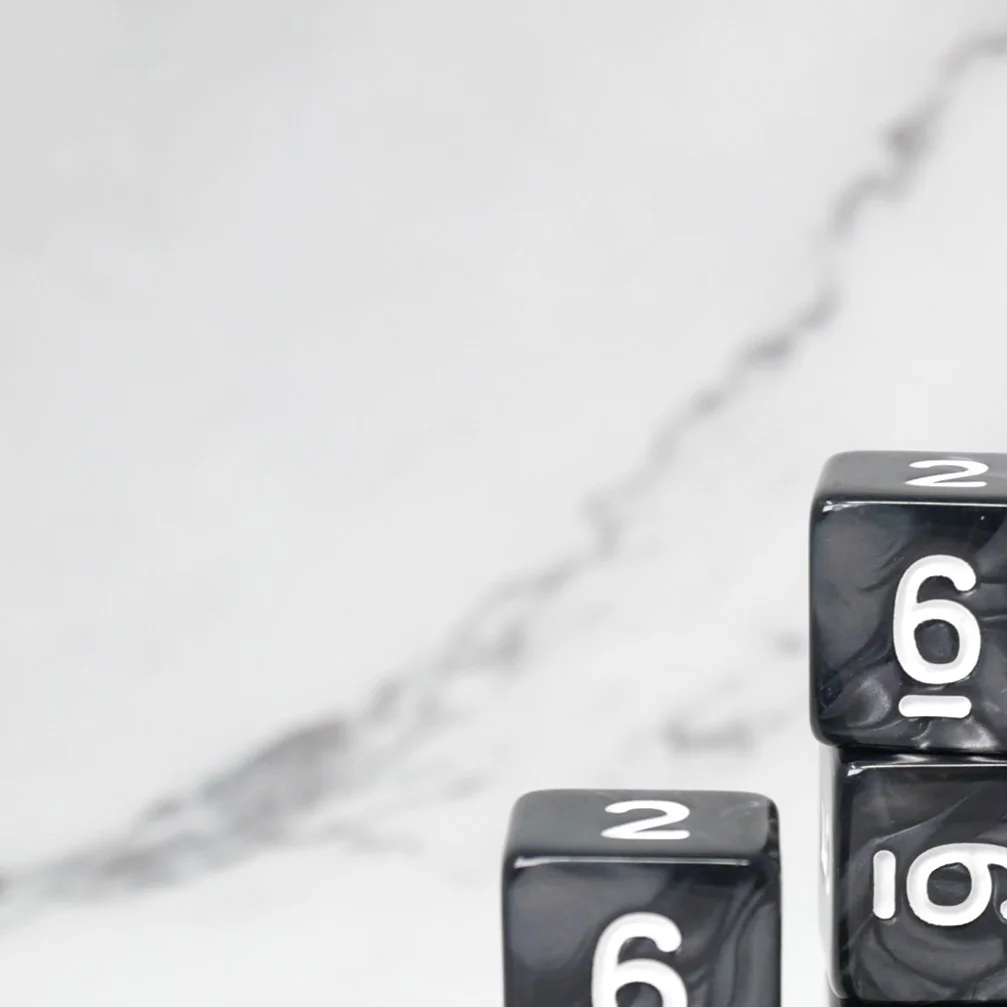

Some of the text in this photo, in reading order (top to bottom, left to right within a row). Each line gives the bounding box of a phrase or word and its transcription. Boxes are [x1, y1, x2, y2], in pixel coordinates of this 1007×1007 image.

[906, 459, 989, 488] 2
[893, 555, 981, 718] 6
[600, 800, 691, 840] 2
